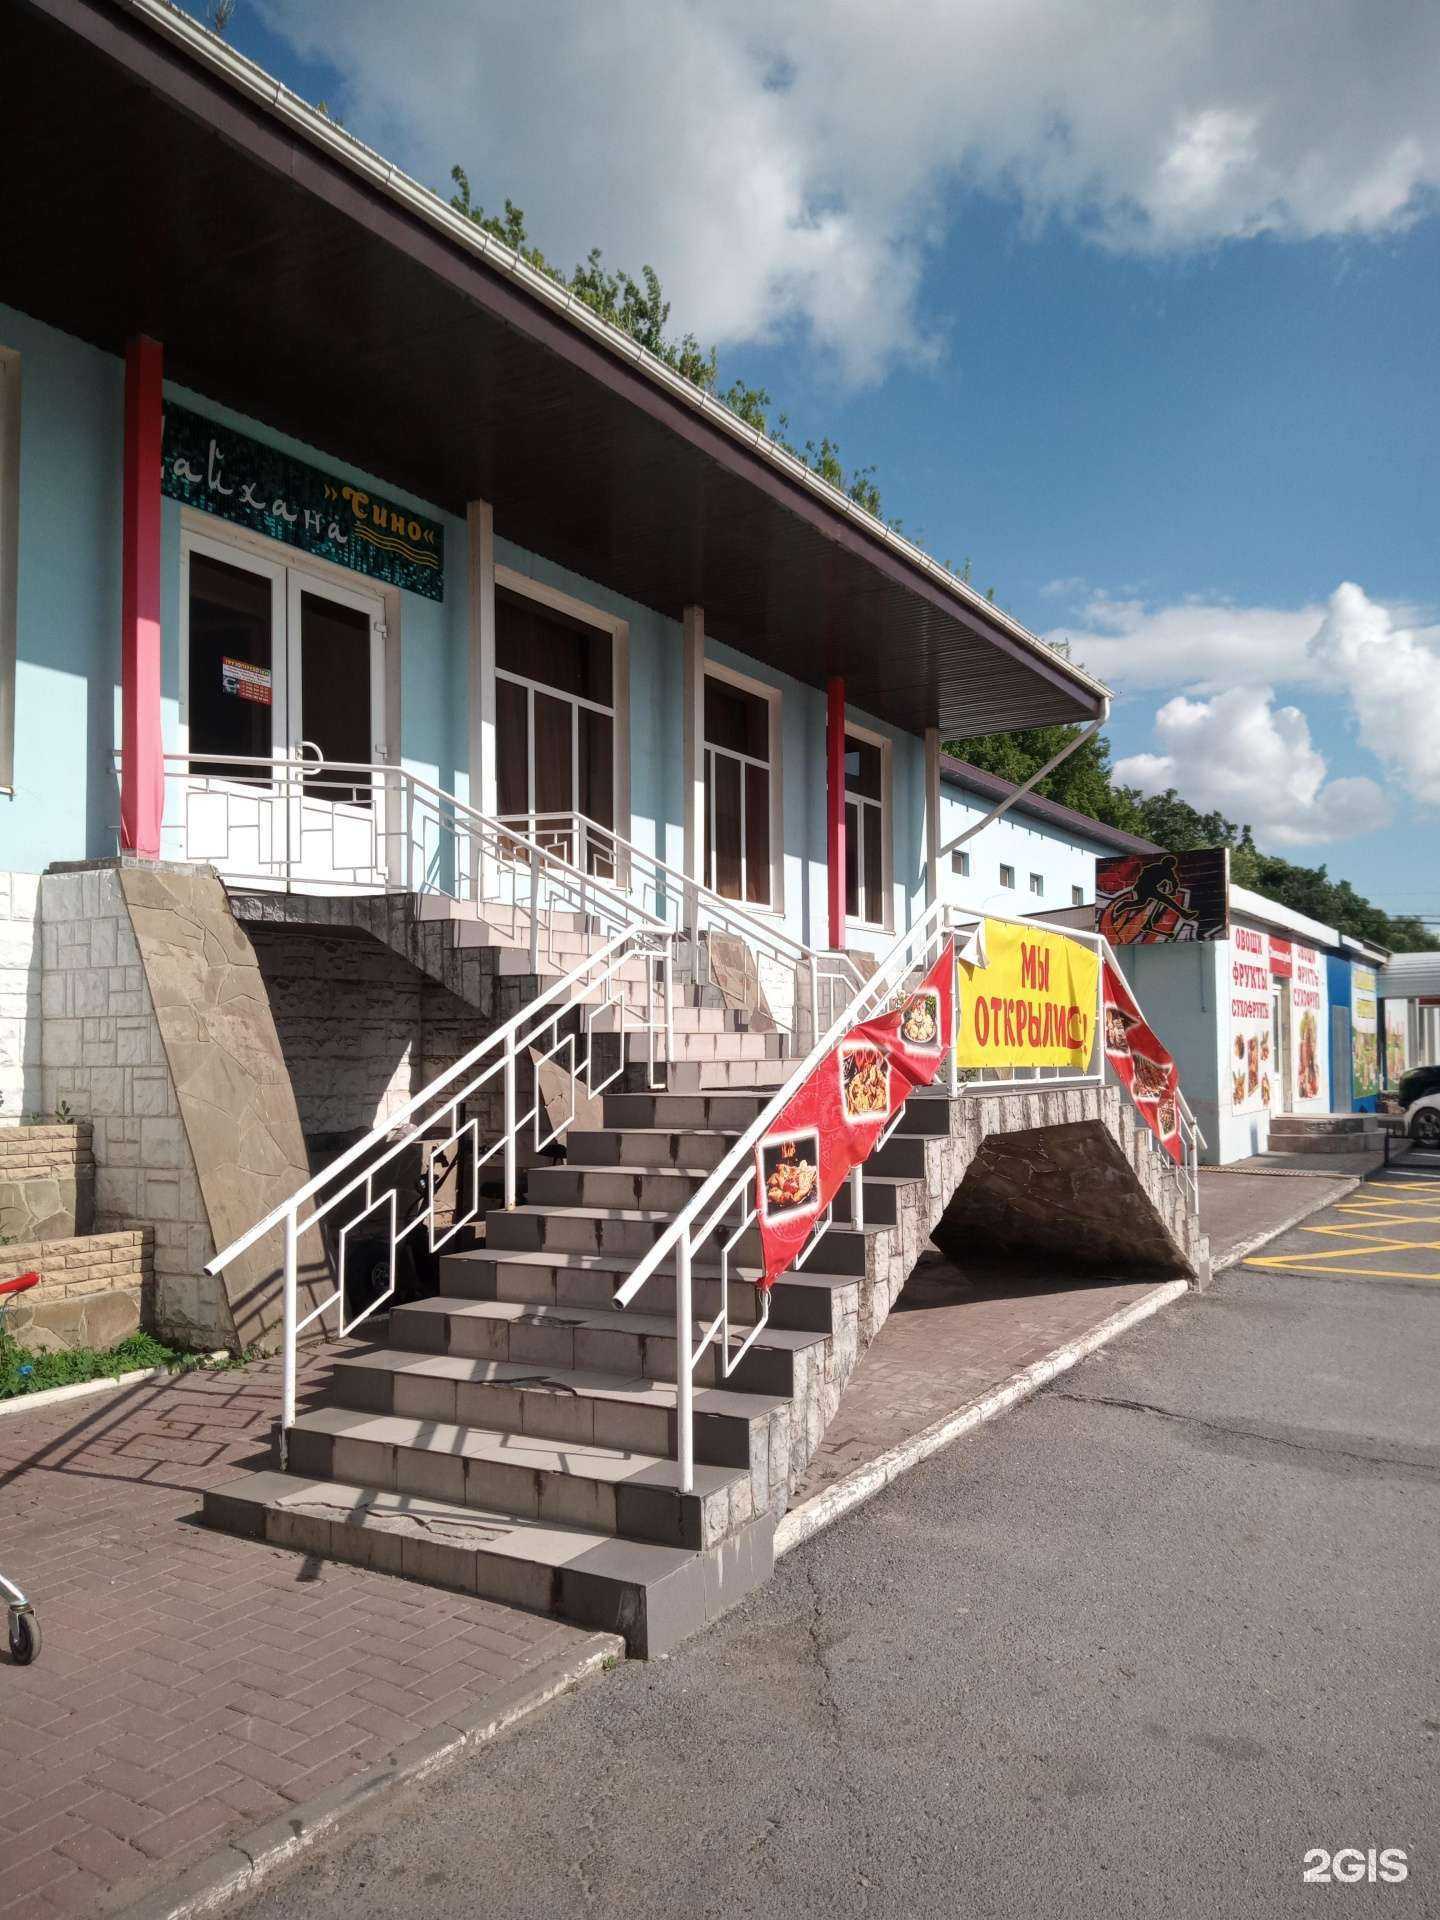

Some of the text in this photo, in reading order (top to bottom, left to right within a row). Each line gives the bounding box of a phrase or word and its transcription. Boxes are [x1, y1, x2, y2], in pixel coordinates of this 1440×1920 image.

[161, 417, 350, 544] айхана
[1235, 928, 1263, 956] ОВОЩИ
[1021, 941, 1050, 992] МЫ
[1232, 961, 1268, 991] ФРУКТЫ
